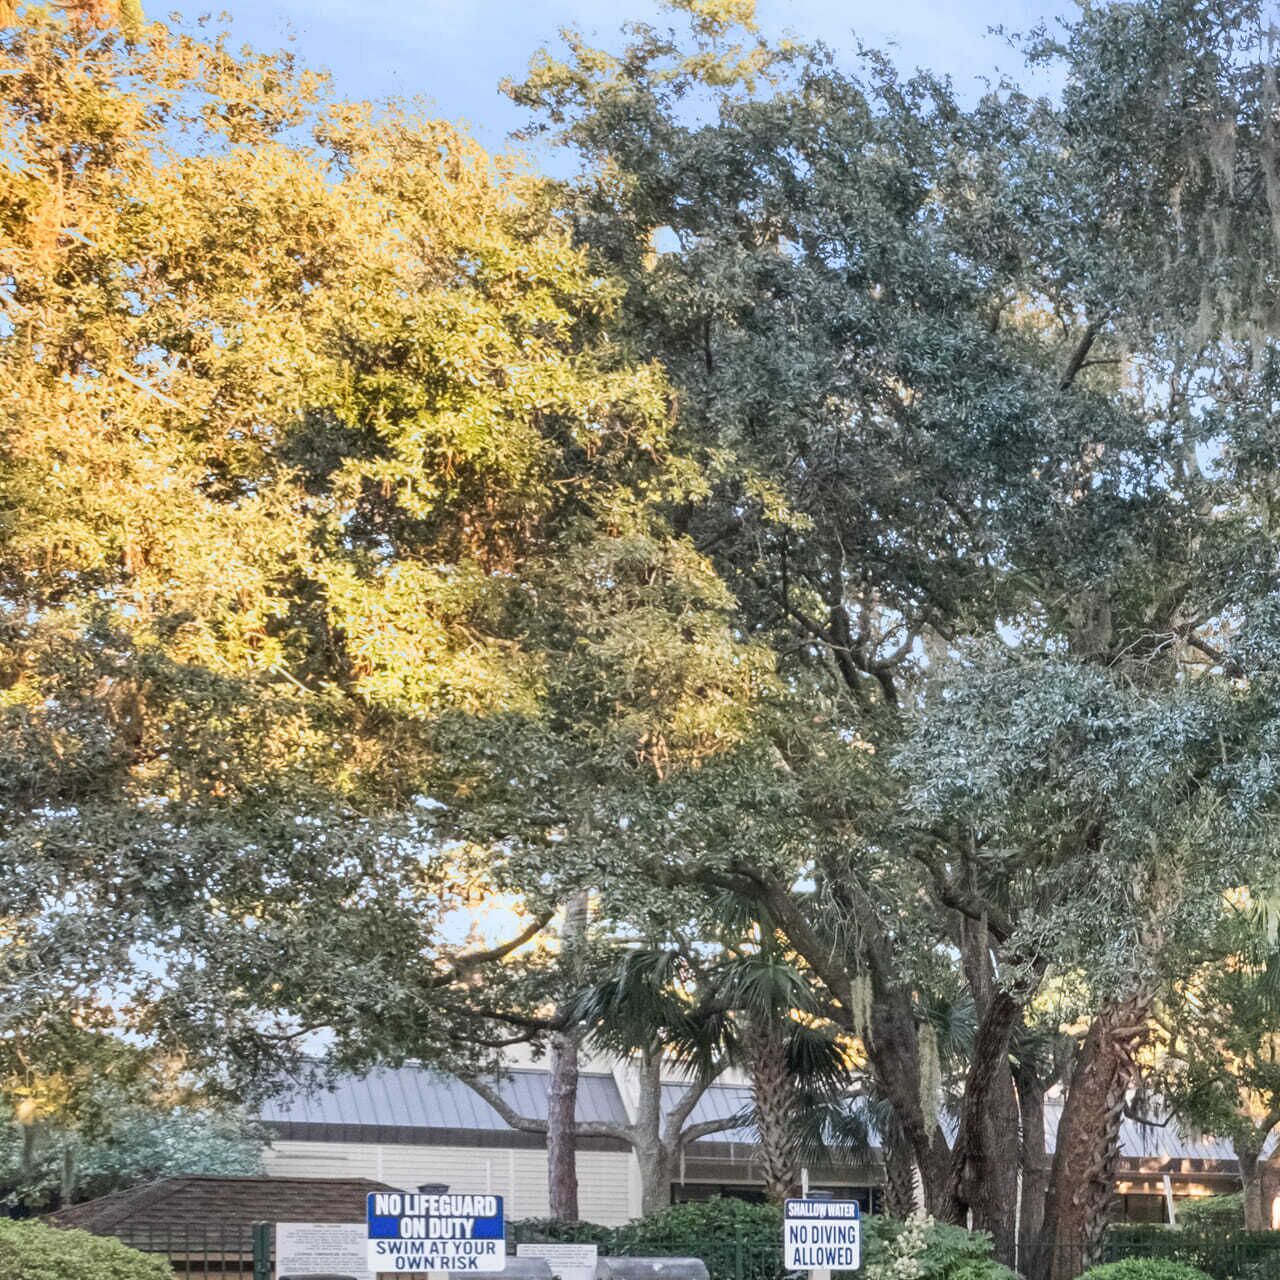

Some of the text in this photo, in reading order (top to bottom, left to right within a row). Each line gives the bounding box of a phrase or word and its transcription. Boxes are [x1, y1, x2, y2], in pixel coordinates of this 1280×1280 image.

[375, 1194, 497, 1217] NO LIFEGUARD
[788, 1202, 855, 1218] SHALLOW WATER
[400, 1217, 475, 1239] ON DUTY
[789, 1225, 856, 1244] NO DIVING
[376, 1241, 496, 1255] SWIM AT YOUR
[793, 1247, 853, 1266] ALLOWED
[395, 1256, 479, 1270] OWN RISK
